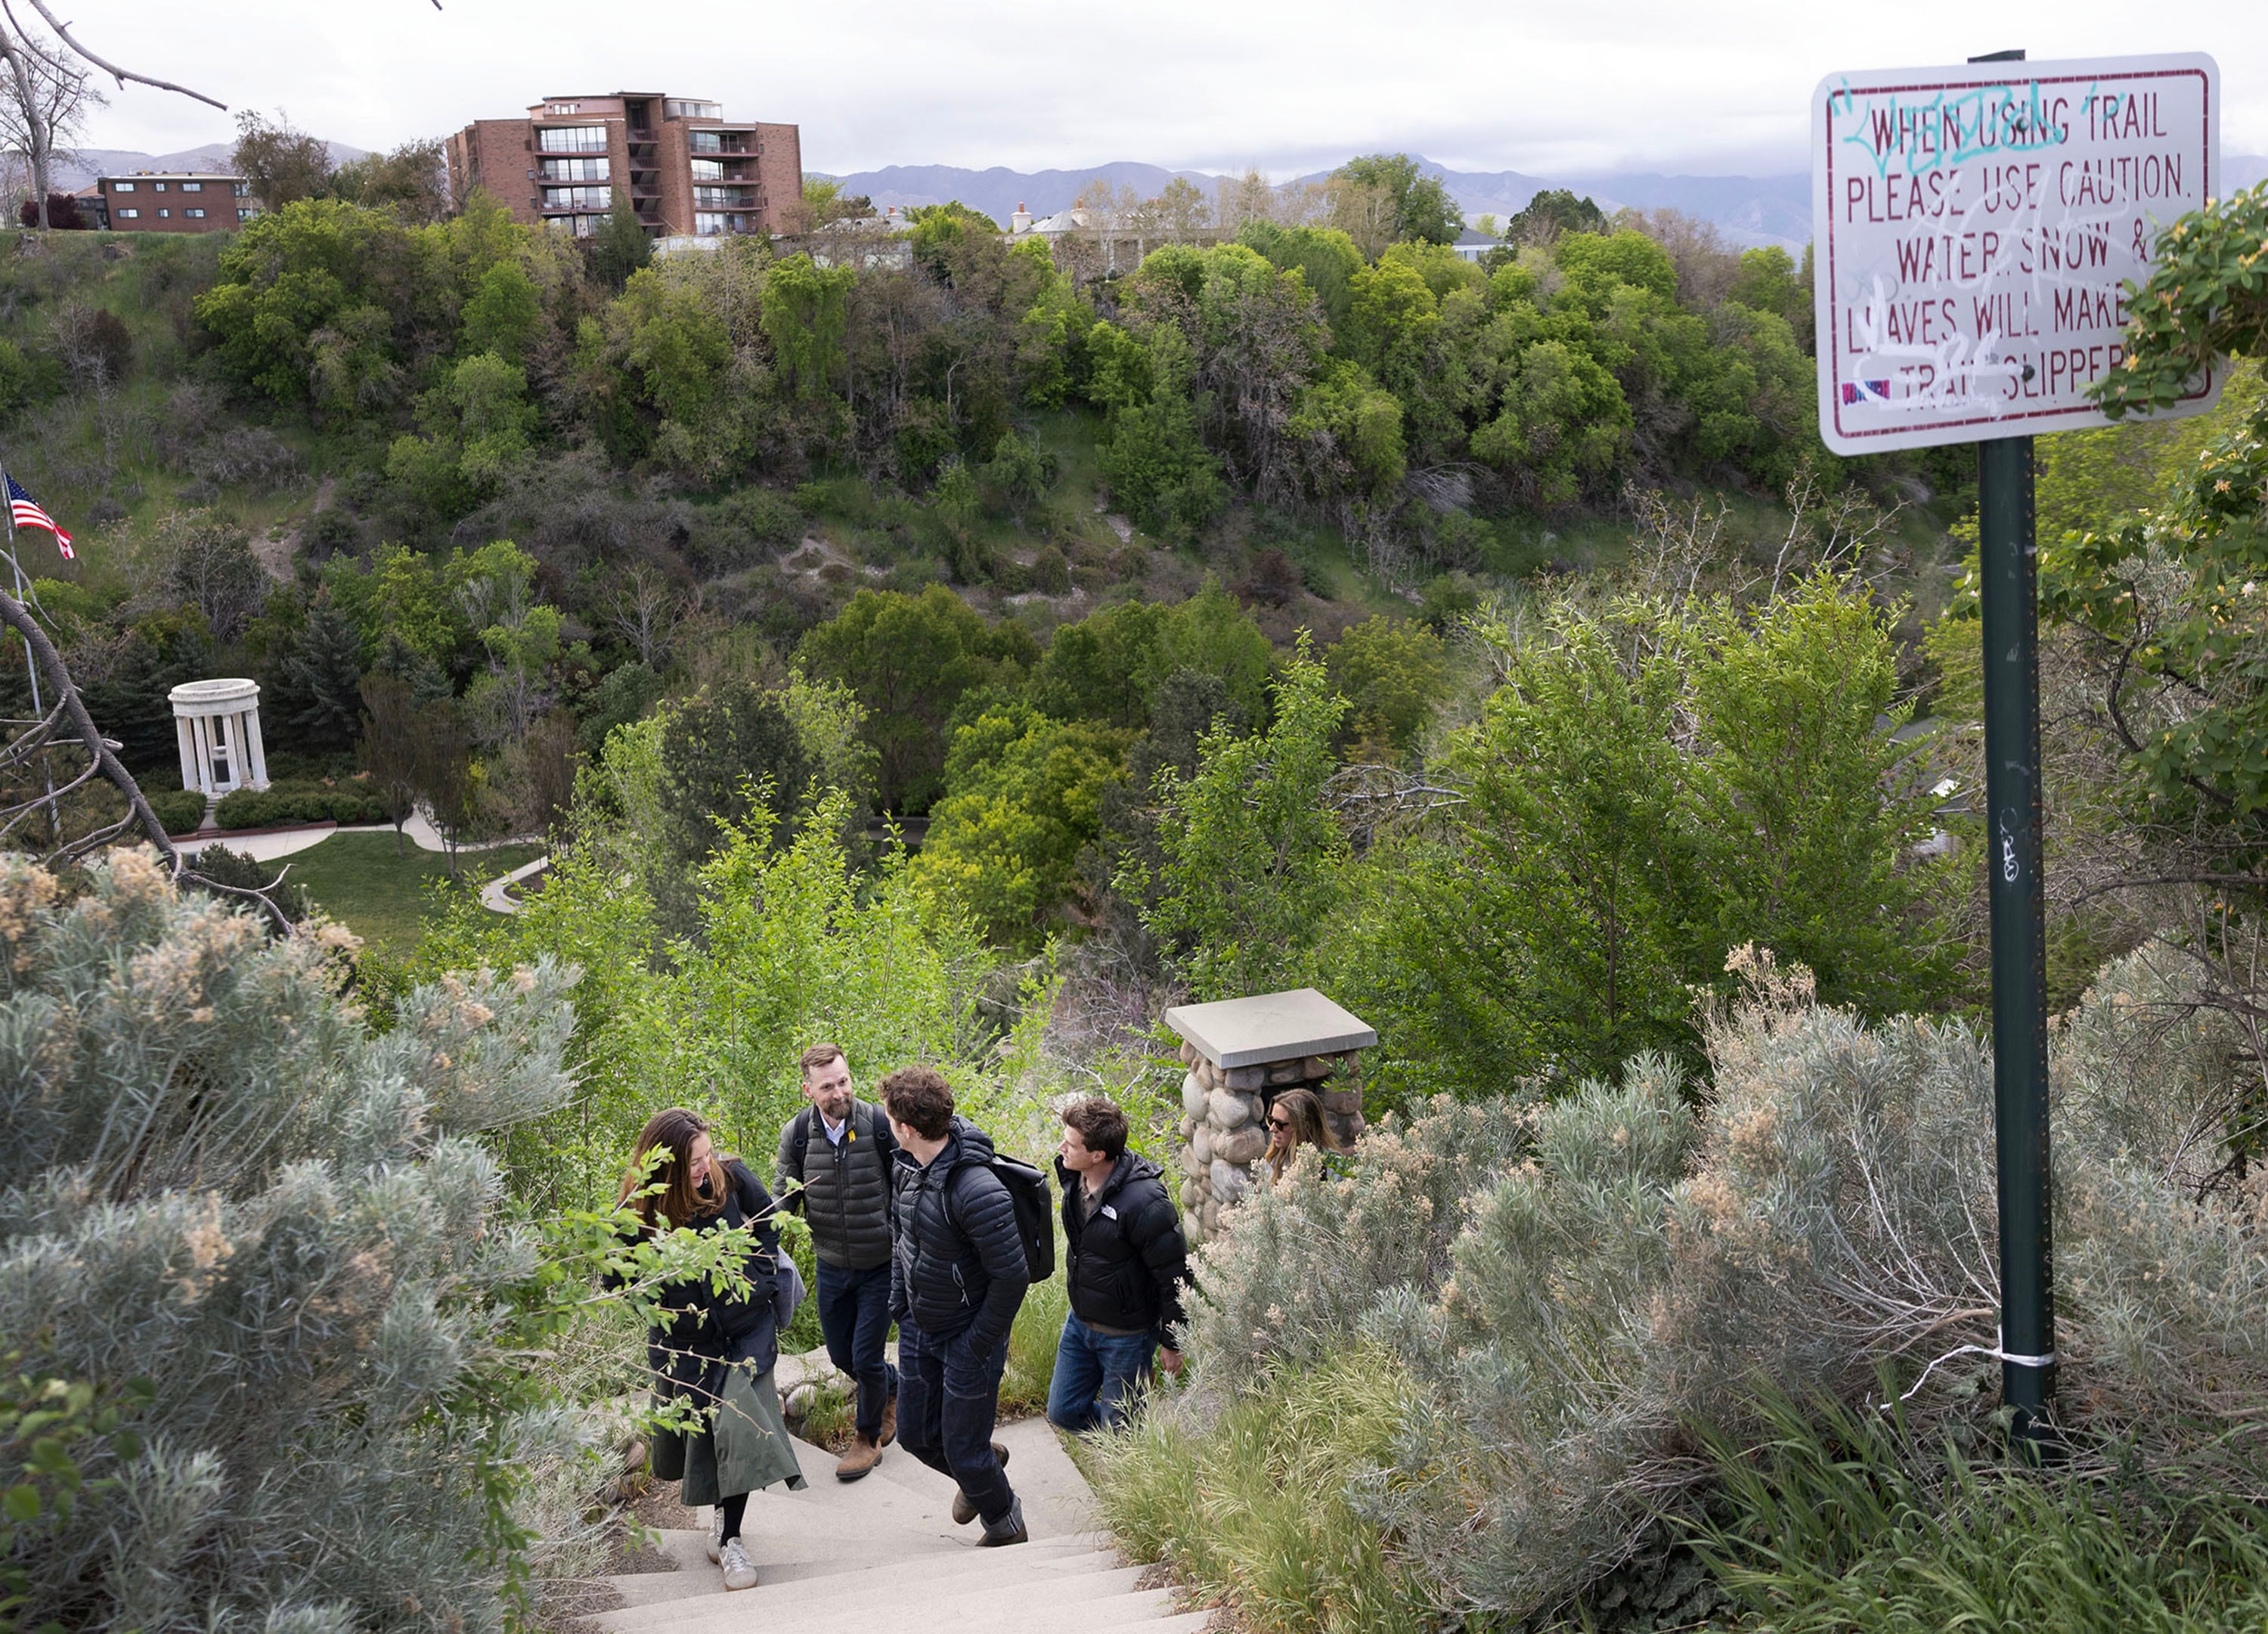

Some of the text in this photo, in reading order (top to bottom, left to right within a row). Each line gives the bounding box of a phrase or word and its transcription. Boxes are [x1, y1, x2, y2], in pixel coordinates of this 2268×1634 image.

[1871, 104, 1961, 156] WHEN
[1979, 98, 2069, 147] USING
[2085, 91, 2167, 142] TRAIL
[1848, 153, 2192, 223] PLEASE USE CAUTION.
[2019, 220, 2110, 274] SNOW
[2132, 217, 2149, 265] &
[1973, 290, 2040, 340] WILL
[2054, 281, 2130, 333] MAKE
[1900, 358, 1976, 411] TRAI
[2003, 343, 2134, 401] SLIPPER
